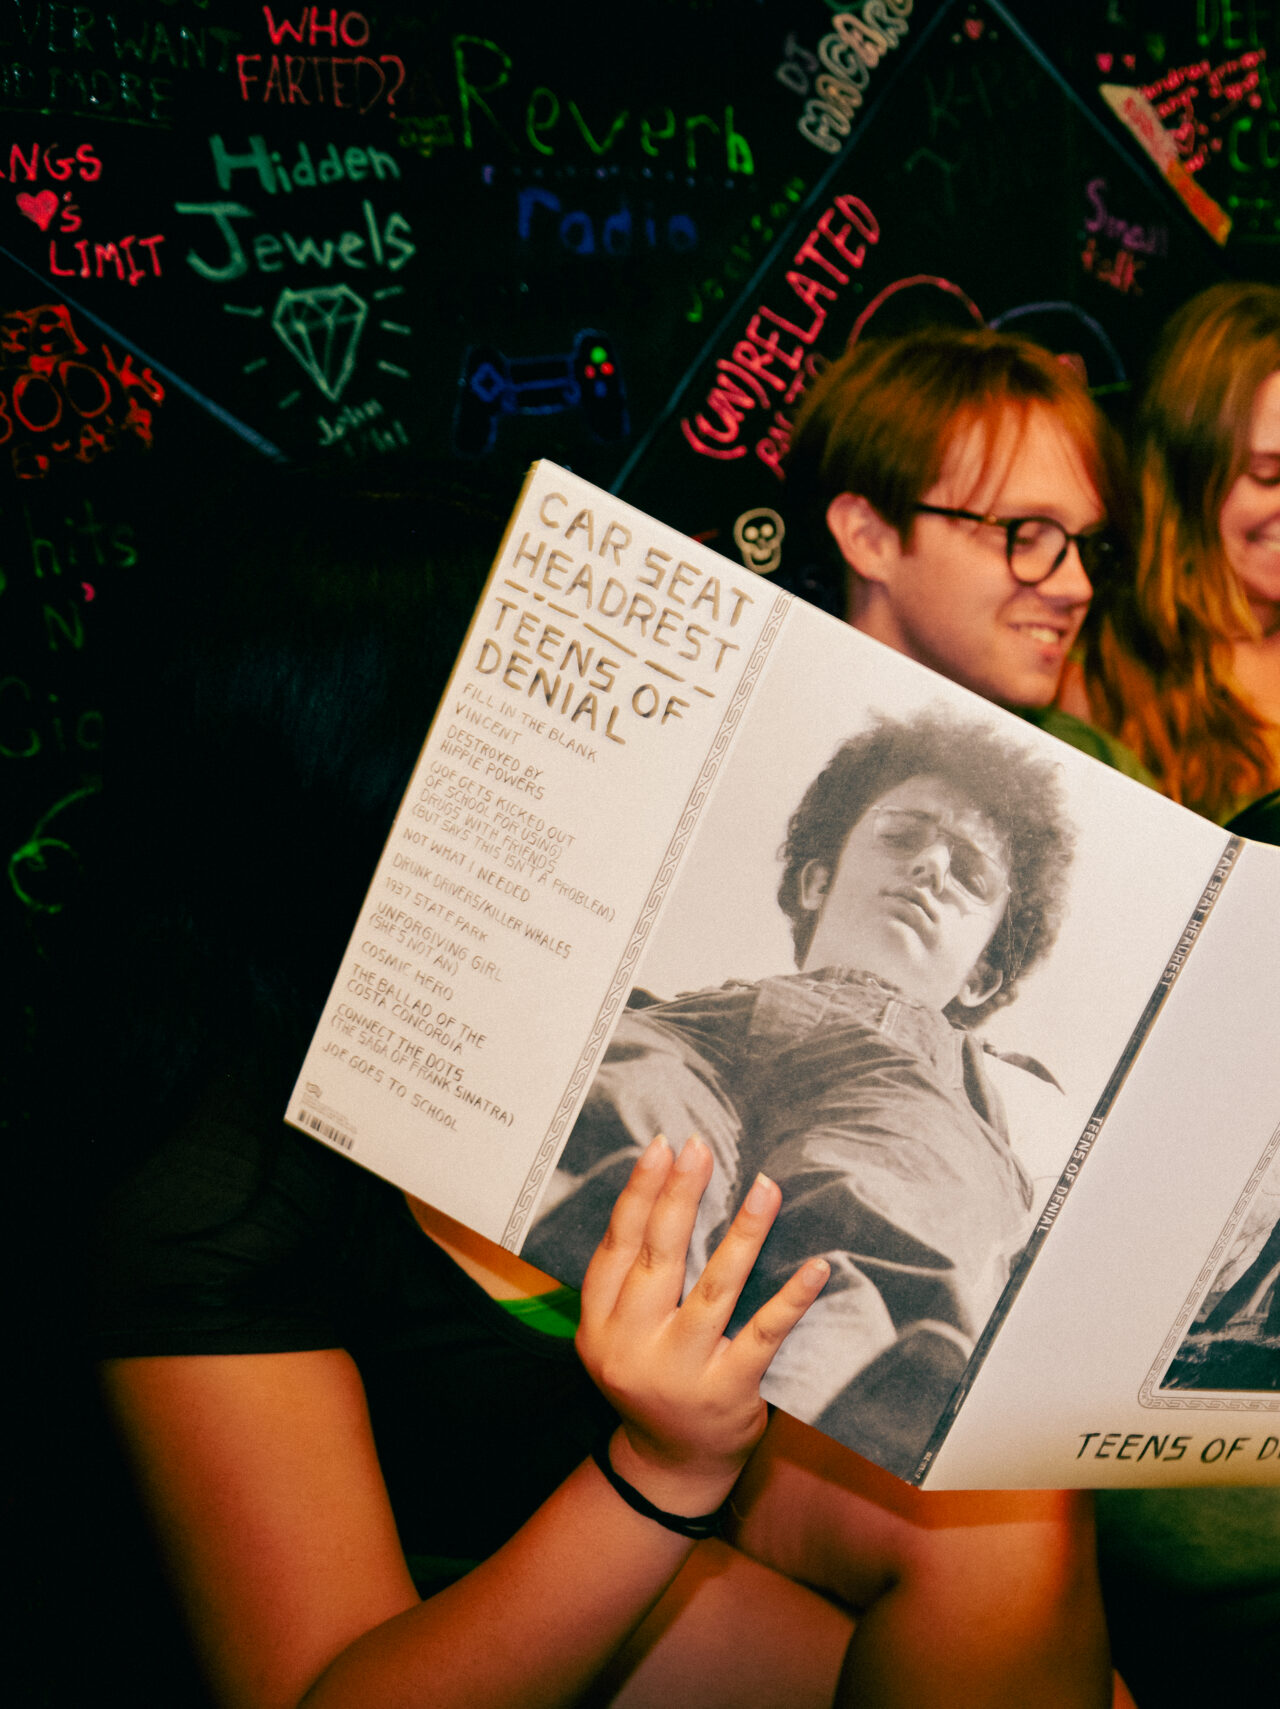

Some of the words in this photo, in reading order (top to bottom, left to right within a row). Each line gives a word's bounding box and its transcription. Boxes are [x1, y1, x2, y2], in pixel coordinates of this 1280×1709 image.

[0, 0, 96, 53] VER
[263, 5, 371, 47] WHO
[236, 54, 406, 119] FARTED?
[451, 33, 755, 175] Reverb
[0, 142, 103, 184] NGS
[208, 133, 400, 194] Hidden
[174, 199, 417, 281] Jewels
[517, 186, 698, 256] radio
[49, 234, 165, 287] LIMIT
[680, 194, 880, 461] (UN)RELATED
[23, 499, 139, 579] hits
[539, 491, 632, 567] CAR
[637, 547, 755, 628] SEAT
[512, 532, 741, 673] HEADREST
[475, 638, 627, 746] DENIAL
[495, 597, 621, 693] TEENS
[632, 683, 691, 726] OF
[447, 725, 521, 773] DESTROYED
[524, 765, 545, 780] BY
[455, 702, 523, 745] VINCENT
[463, 682, 494, 708] FILL
[499, 700, 517, 718] IN
[522, 711, 549, 735] THE
[548, 728, 598, 764] BLANK
[430, 760, 458, 781] (JOE
[458, 774, 495, 803] GETS
[497, 797, 546, 833] KICKED
[547, 826, 577, 848] OUT
[439, 739, 481, 771] HIPPIE
[485, 765, 546, 800] POWERS
[419, 788, 461, 820] DRUGS
[464, 816, 500, 841] WITH
[502, 835, 558, 874] FRIENDS
[425, 775, 443, 793] OF
[444, 786, 489, 817] SCHOOL
[493, 812, 521, 834] FOR
[521, 829, 563, 860] USING)
[403, 828, 430, 848] NOT
[429, 842, 467, 866] WHAT
[477, 866, 532, 903] NEEDED
[411, 803, 440, 825] (BUT
[441, 819, 470, 842] SAYS
[472, 834, 502, 860] THIS
[504, 856, 537, 878] ISN'T
[537, 870, 548, 885] A
[552, 878, 617, 923] PROBLEM)
[1196, 882, 1222, 916] SEAT
[1215, 847, 1238, 879] CAR
[376, 902, 468, 962] UNFORGIVING
[470, 955, 504, 983] GIRL
[385, 876, 412, 898] 1937
[414, 892, 456, 922] STATE
[455, 914, 489, 943] PARK
[391, 852, 432, 882] DRUNK
[524, 924, 572, 960] WHALES
[361, 940, 413, 977] COSMIC
[414, 970, 455, 1001] HERO
[405, 935, 434, 960] NOT
[433, 953, 460, 977] AN)
[1160, 917, 1203, 989] HEADREST
[335, 1002, 397, 1045] CONNECT
[398, 1034, 425, 1060] THE
[425, 1050, 465, 1082] DOTS
[347, 978, 387, 1008] COSTA
[391, 1004, 464, 1055] CONCORDIA
[352, 963, 379, 988] THE
[378, 979, 434, 1019] BALLAD
[437, 1012, 458, 1030] OF
[459, 1022, 488, 1050] THE
[322, 1041, 348, 1063] JOE
[348, 1055, 385, 1083] GOES
[388, 1077, 408, 1099] TO
[410, 1093, 459, 1132] SCHOOL
[330, 1014, 356, 1039] (THE
[356, 1032, 391, 1058] SAGA
[390, 1049, 411, 1067] OF
[409, 1060, 453, 1090] FRANK
[454, 1084, 515, 1128] SINATRA)
[1063, 1162, 1079, 1183] OF
[1073, 1116, 1105, 1162] TEENS
[1036, 1185, 1069, 1233] DENIAL
[1076, 1432, 1194, 1463] TEENS
[1200, 1437, 1252, 1464] OF
